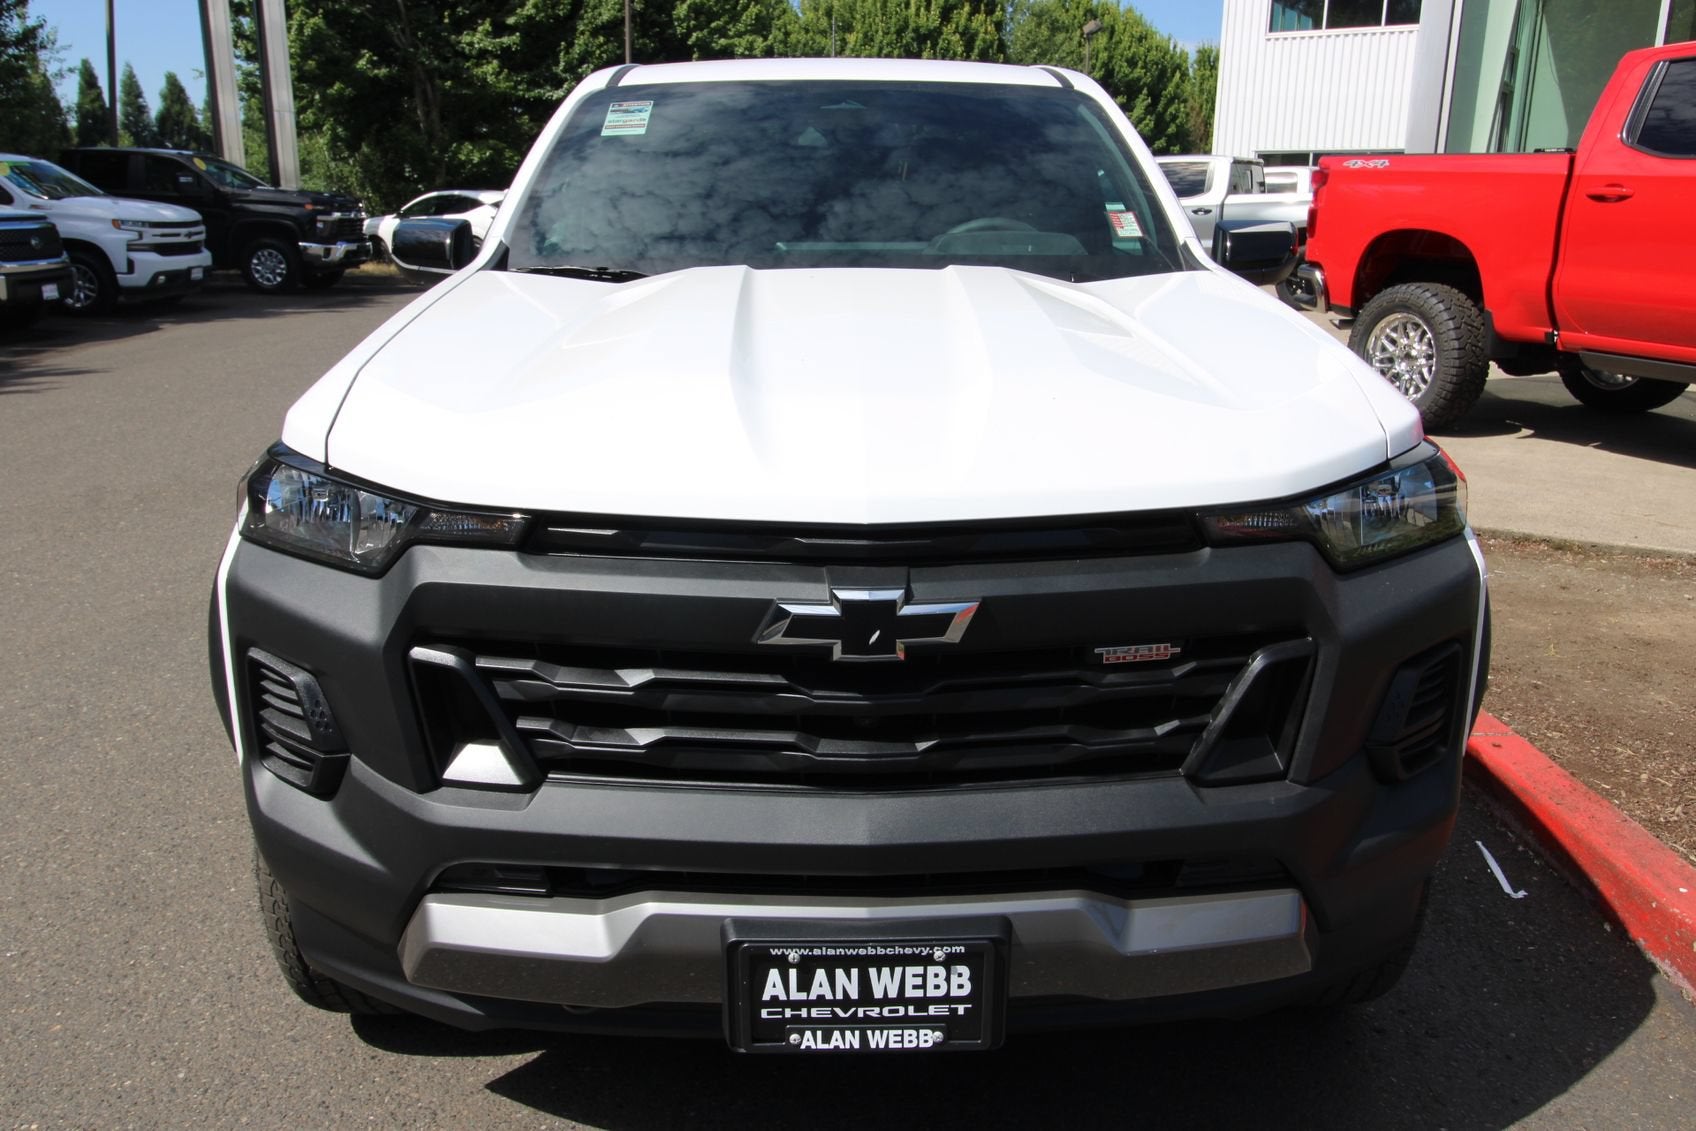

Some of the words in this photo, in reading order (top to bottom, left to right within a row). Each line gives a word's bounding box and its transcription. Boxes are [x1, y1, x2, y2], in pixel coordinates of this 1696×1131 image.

[1103, 652, 1169, 664] BOSS
[769, 945, 965, 957] www.alanwebbchevy.com
[762, 968, 859, 1001] ALAN
[868, 965, 972, 999] WEBB
[761, 1004, 972, 1019] CHEVROLET
[800, 1030, 860, 1049] ALAN
[866, 1029, 934, 1048] WEBB
